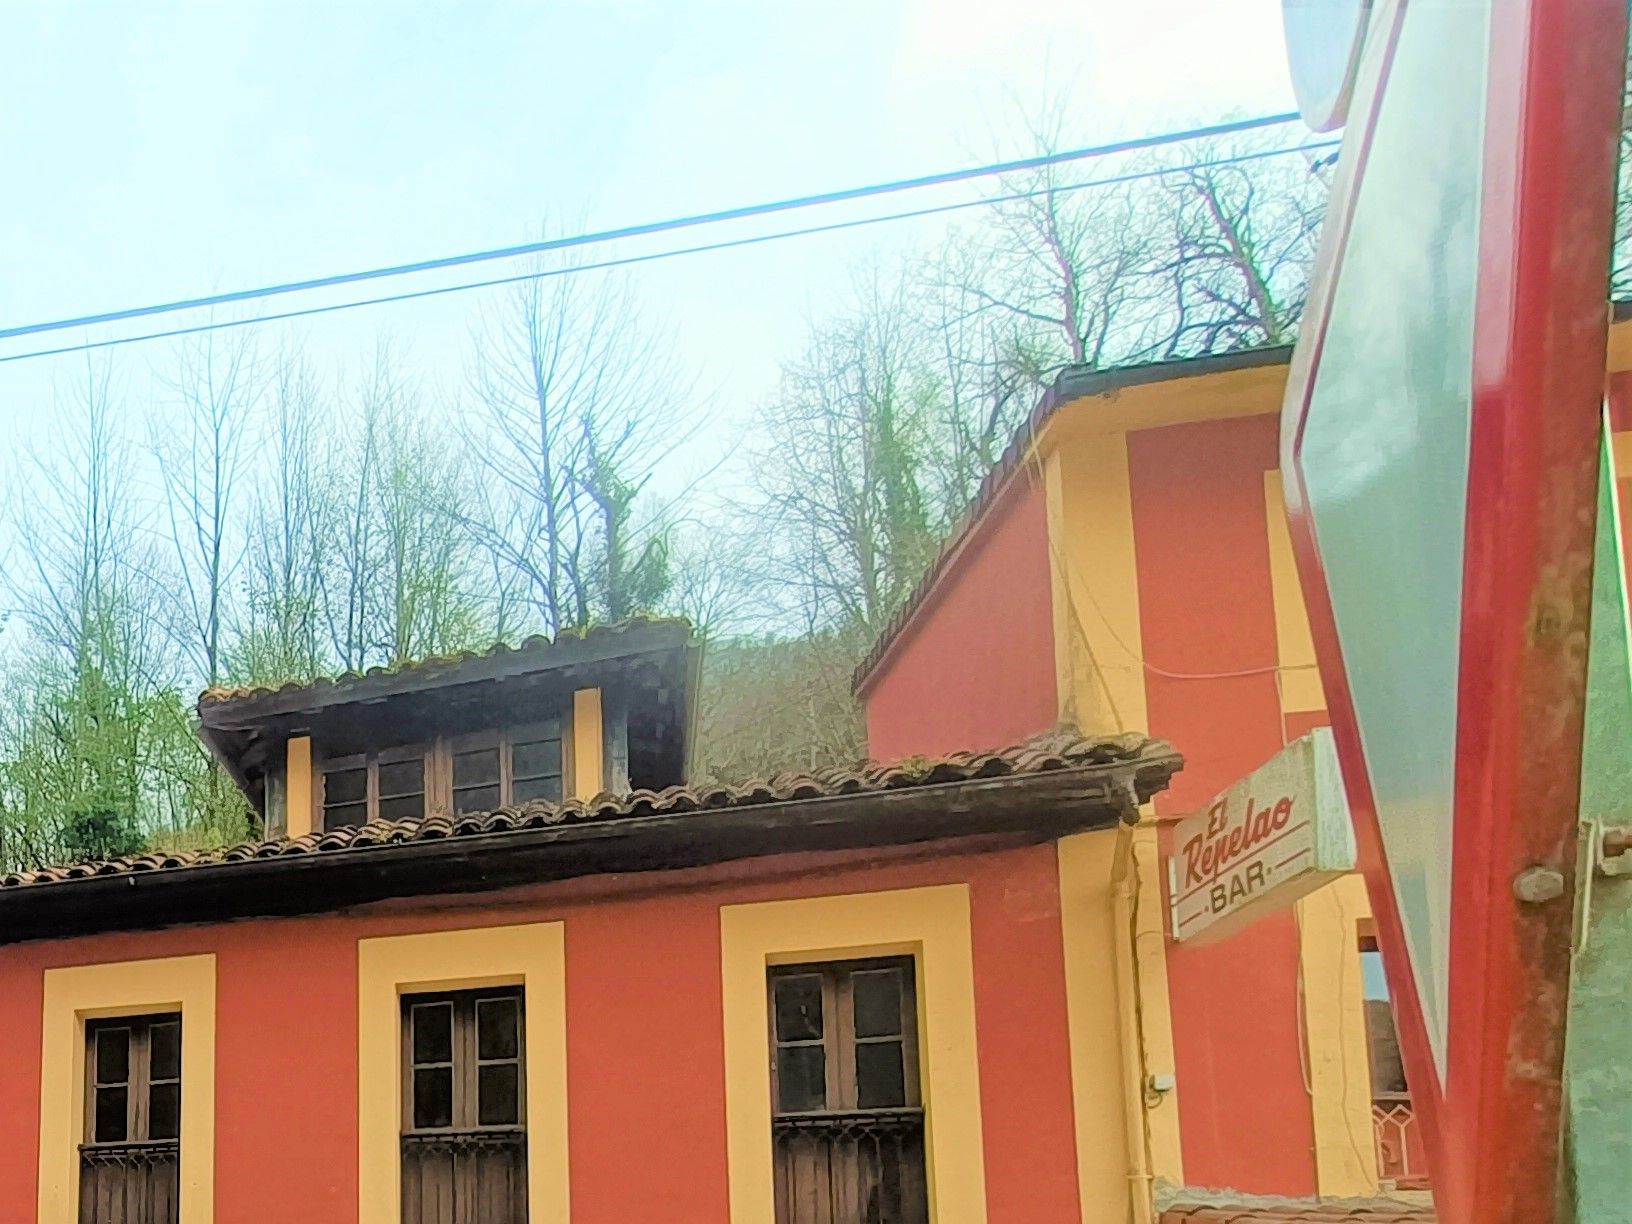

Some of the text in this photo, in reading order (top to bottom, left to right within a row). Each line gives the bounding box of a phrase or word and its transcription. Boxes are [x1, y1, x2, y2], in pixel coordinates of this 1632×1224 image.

[1182, 796, 1295, 889] Repelao
[1206, 797, 1228, 840] El
[1209, 860, 1266, 914] BAR
